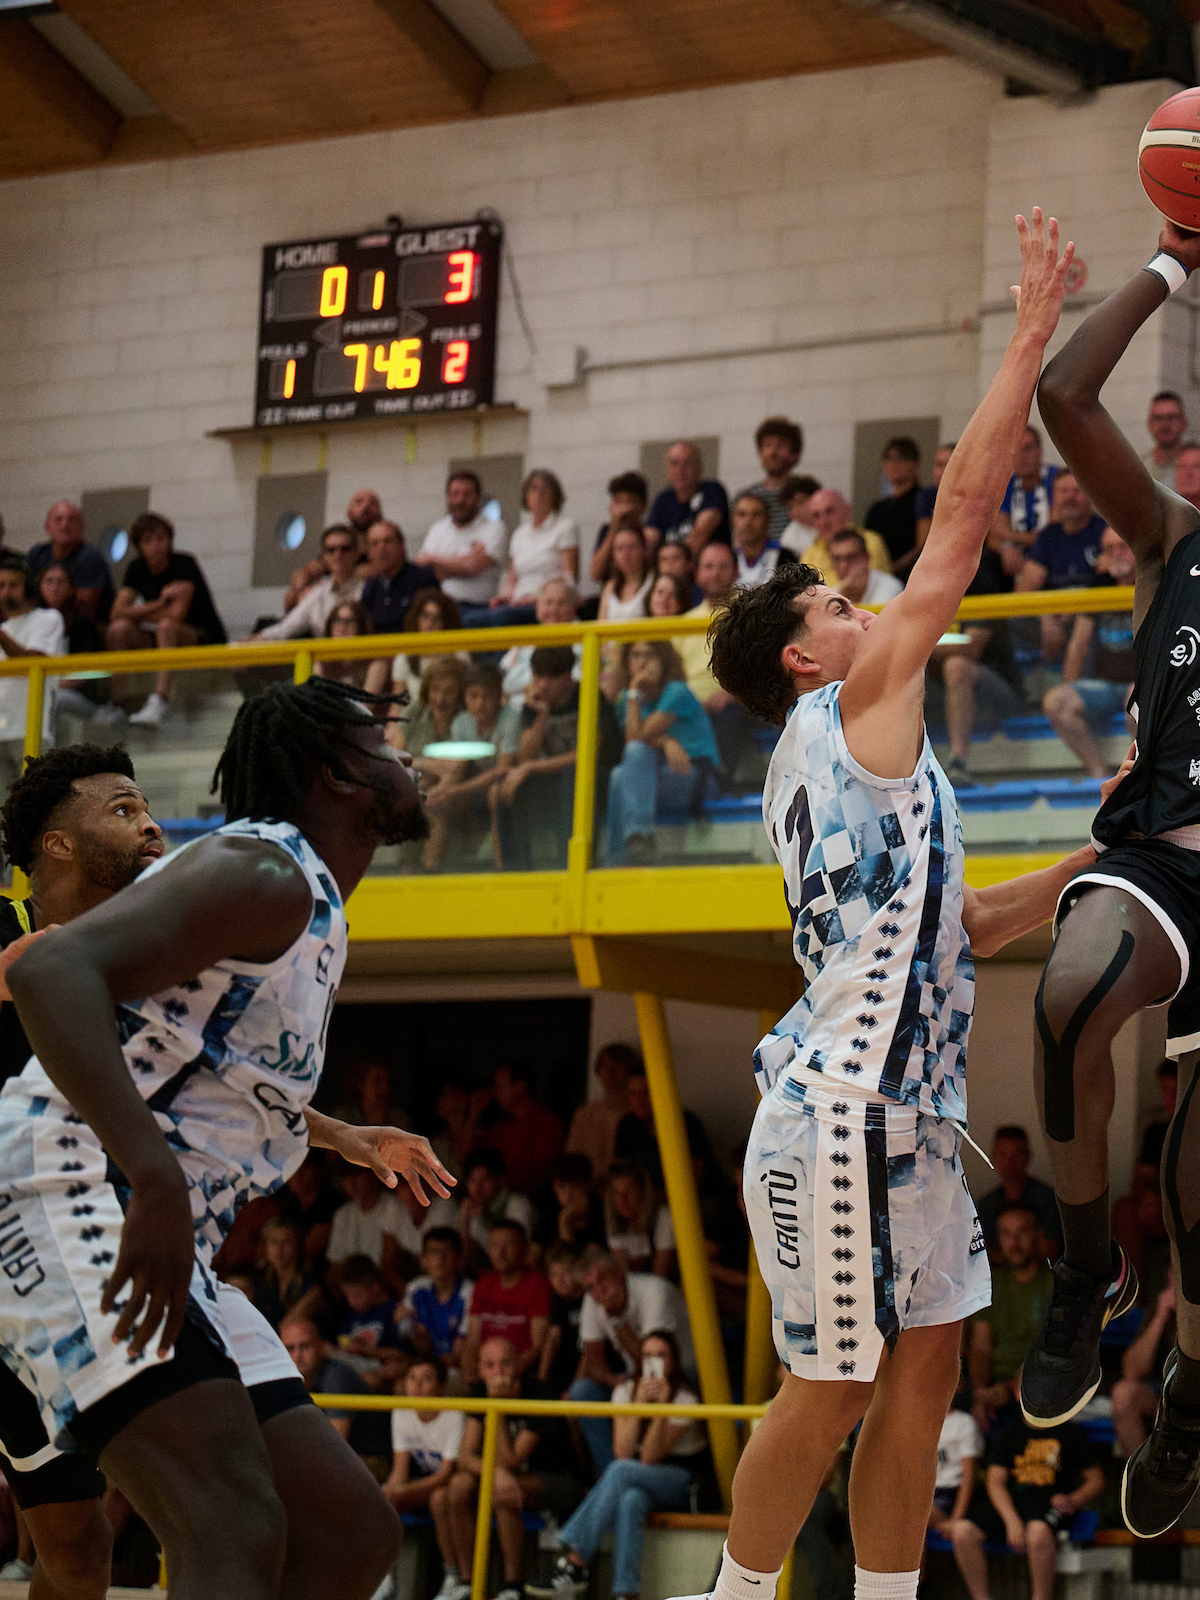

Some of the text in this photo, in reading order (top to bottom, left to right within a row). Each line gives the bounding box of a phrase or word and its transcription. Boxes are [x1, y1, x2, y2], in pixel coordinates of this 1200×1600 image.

[275, 242, 338, 269] HOME
[395, 225, 482, 257] GUEST
[319, 266, 348, 317] 0
[372, 270, 385, 310] 1
[444, 251, 475, 304] 3
[283, 359, 296, 399] 1
[444, 341, 470, 383] 2
[760, 1169, 801, 1270] CANTÙ
